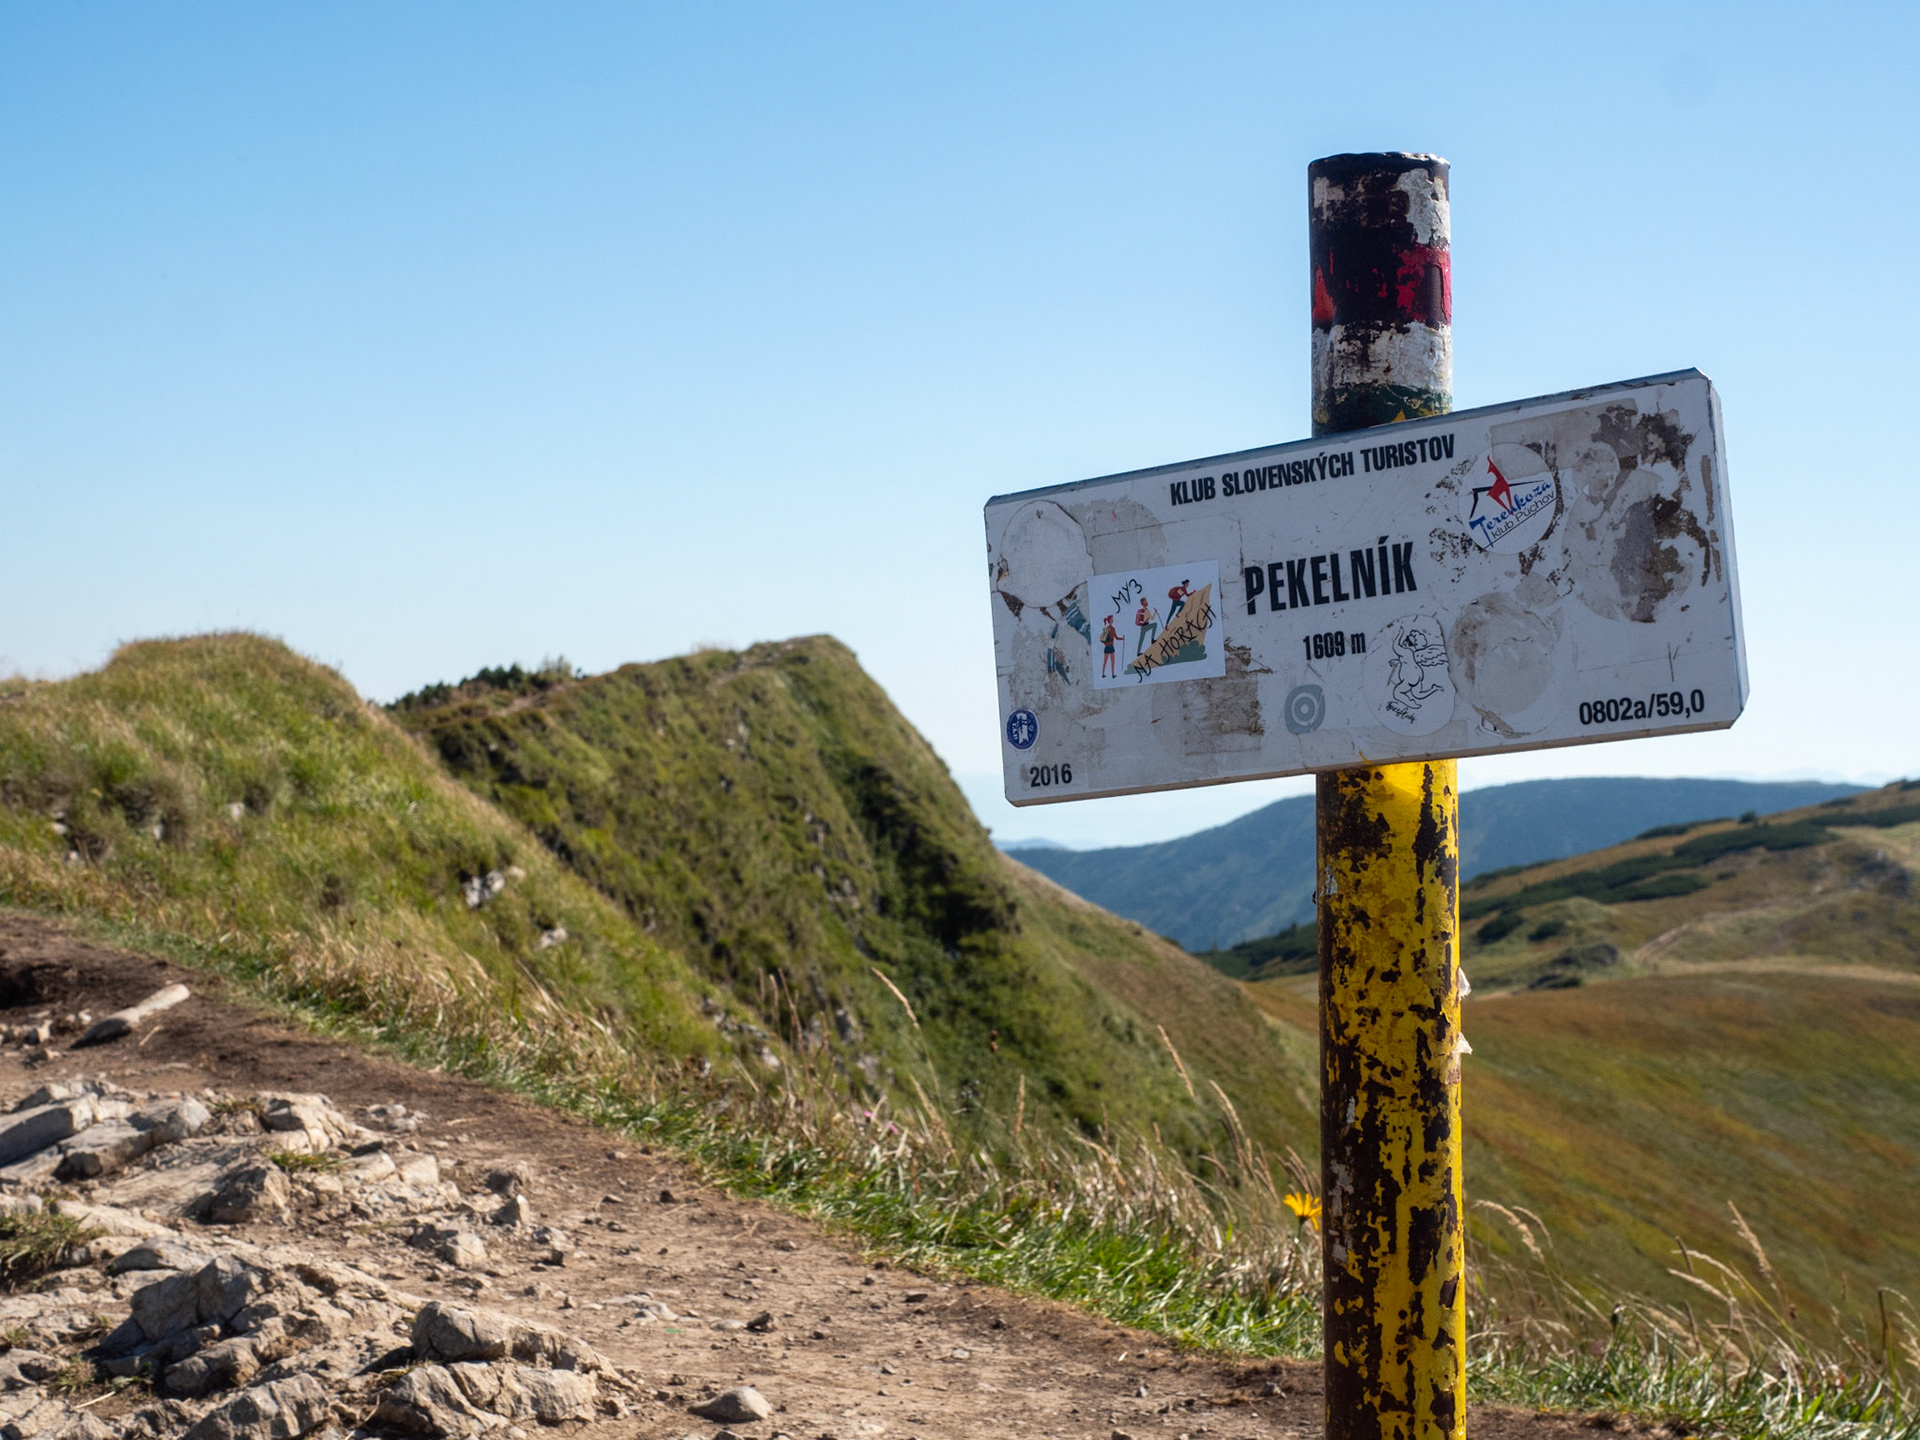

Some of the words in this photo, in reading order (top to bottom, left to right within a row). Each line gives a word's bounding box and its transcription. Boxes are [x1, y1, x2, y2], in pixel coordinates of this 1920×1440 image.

[1170, 476, 1216, 506] KLUB
[1222, 451, 1354, 497] SLOVENSKÝCH
[1360, 433, 1455, 473] TURISTOV
[1491, 519, 1515, 539] klub
[1514, 490, 1555, 522] Púchov
[1244, 535, 1418, 615] PEKELNÍK
[1302, 630, 1346, 660] 1609
[1350, 632, 1367, 655] m
[1133, 653, 1162, 683] NA
[1579, 689, 1705, 725] 0802a/59,0
[1029, 763, 1072, 787] 2016
